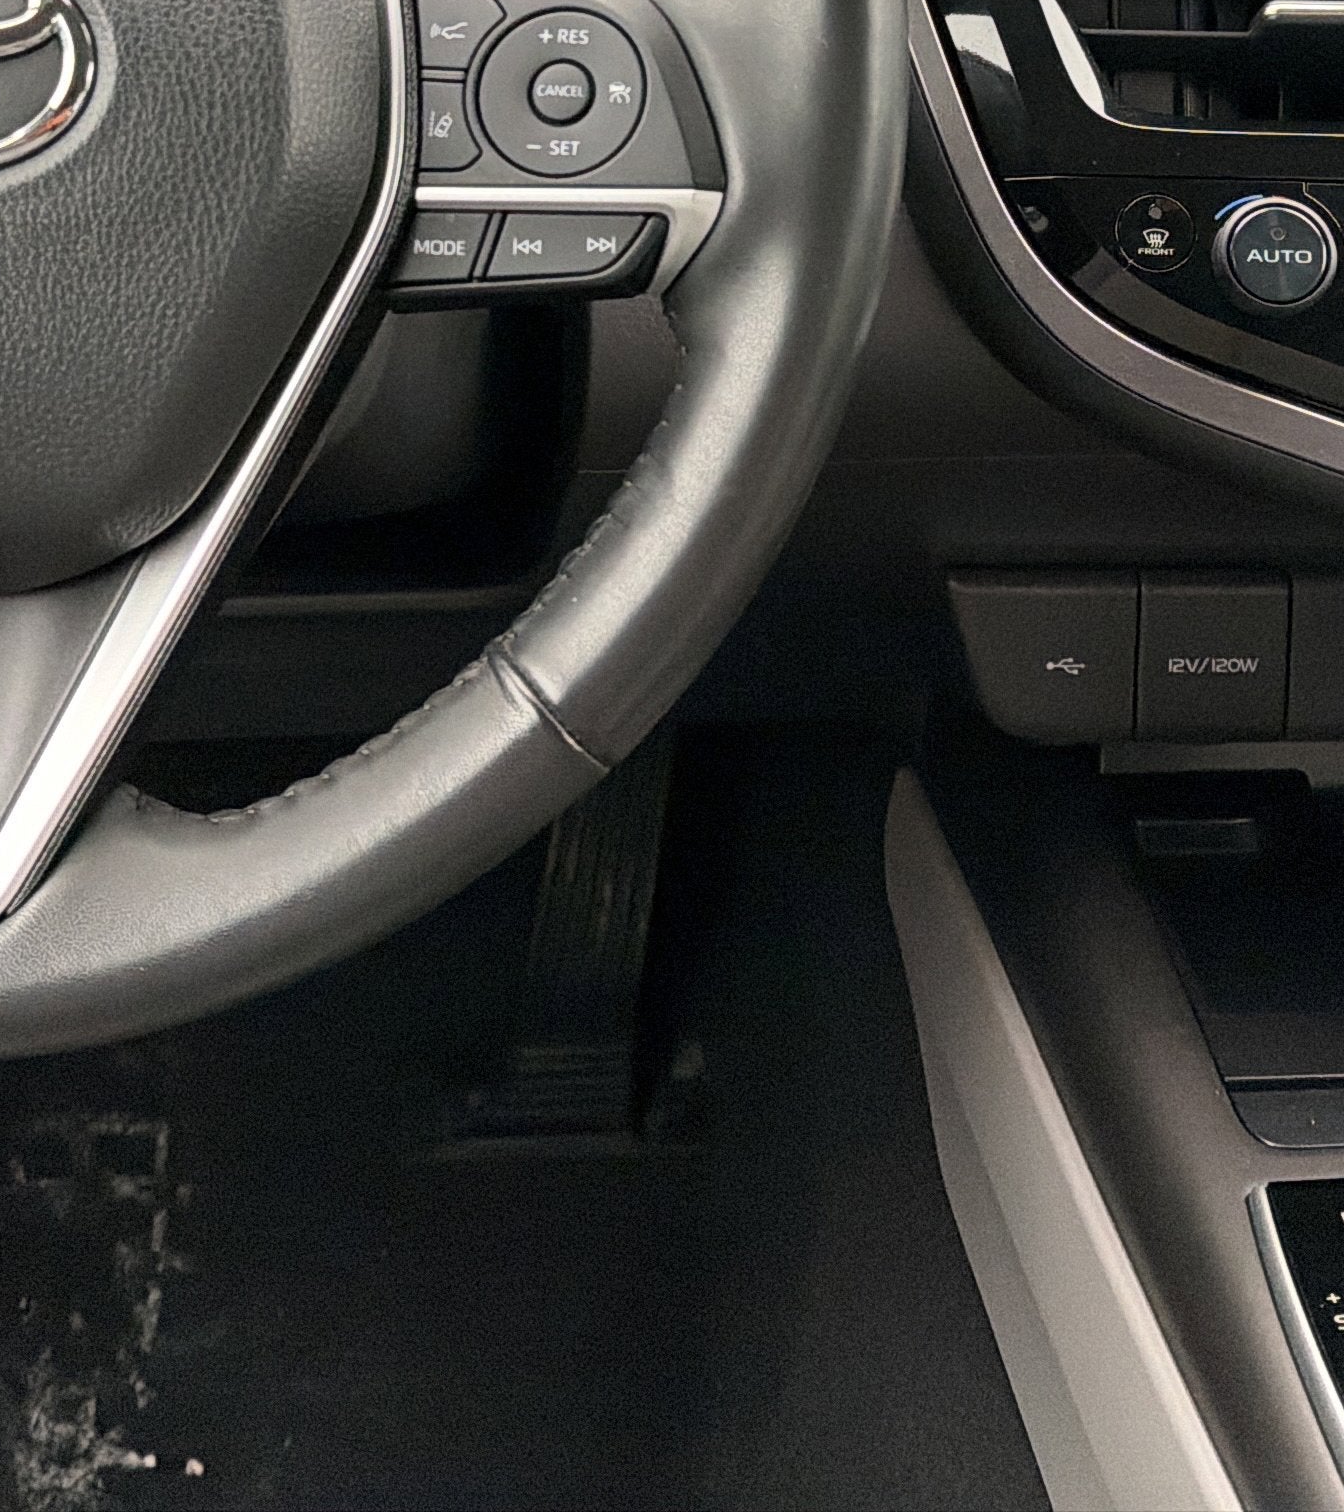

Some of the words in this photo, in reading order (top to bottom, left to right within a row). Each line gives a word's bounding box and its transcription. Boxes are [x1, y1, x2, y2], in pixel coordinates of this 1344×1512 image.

[536, 83, 585, 98] CANCEL
[414, 240, 465, 256] MODE
[1137, 247, 1175, 256] FRONT
[1247, 249, 1312, 263] AUTO
[1169, 658, 1259, 673] 12V/120W
